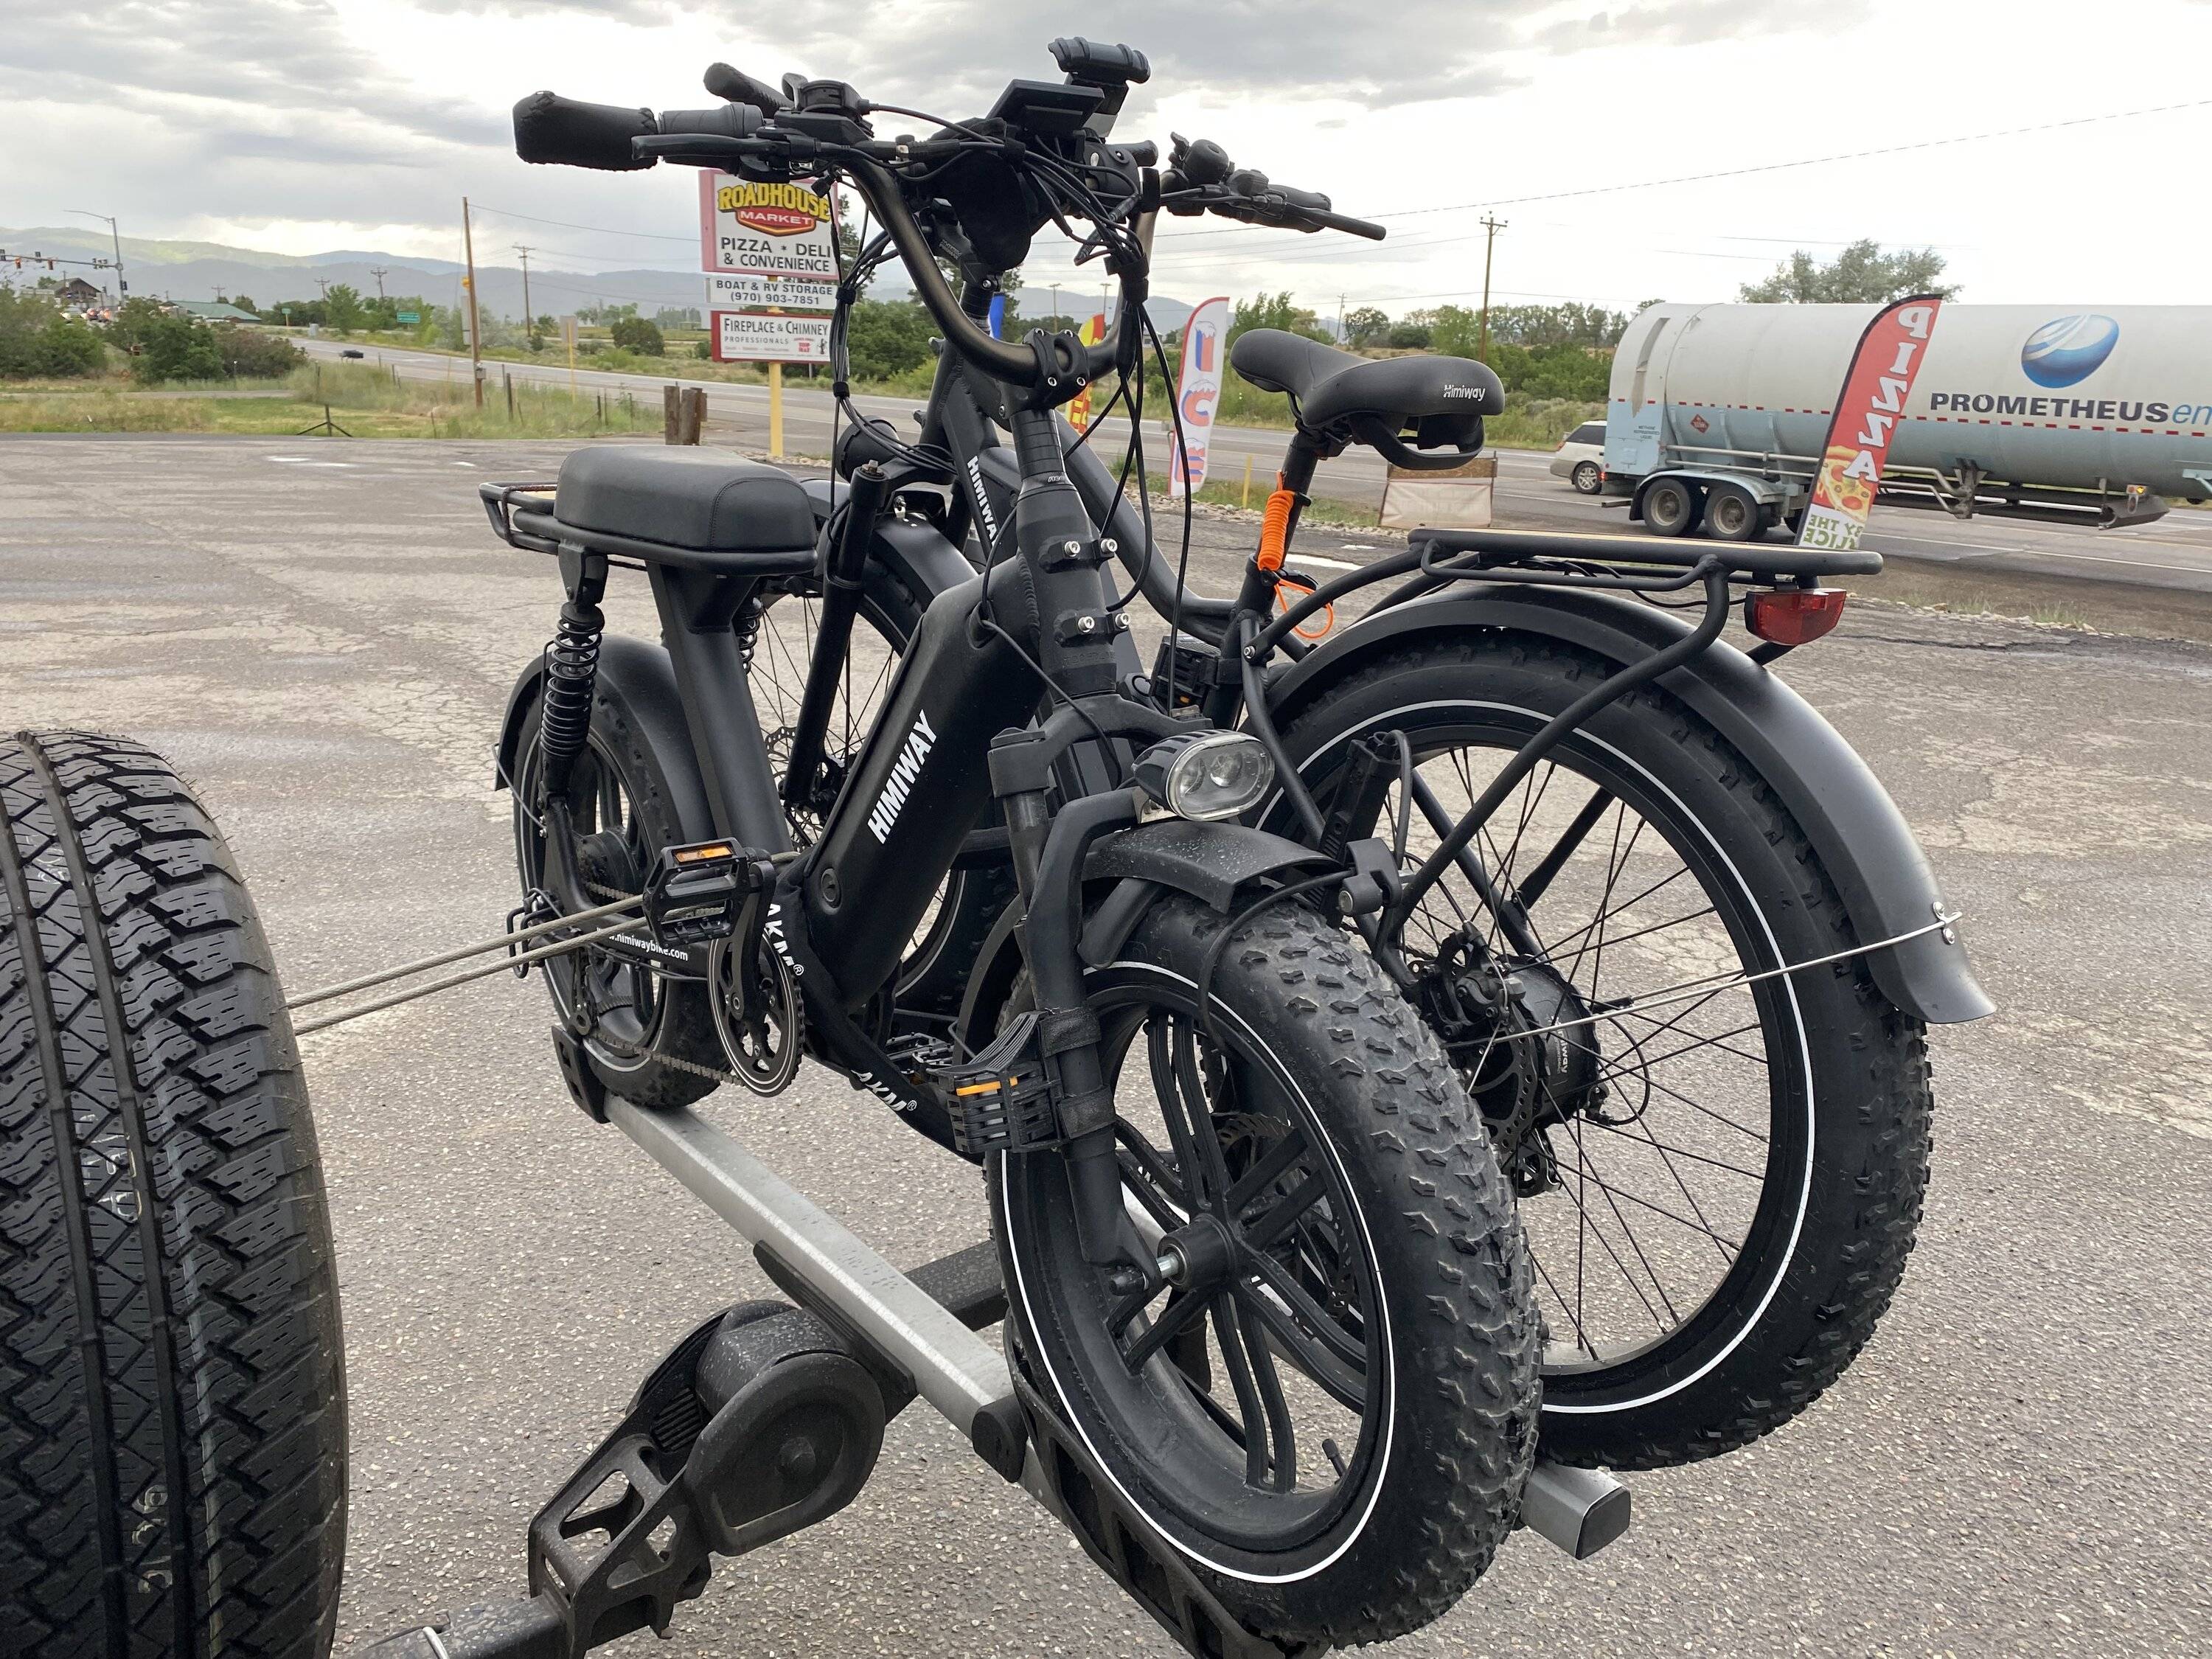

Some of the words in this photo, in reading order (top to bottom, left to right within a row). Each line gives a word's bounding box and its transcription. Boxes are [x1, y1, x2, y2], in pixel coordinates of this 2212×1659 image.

[718, 182, 831, 223] ROADHOUSE
[740, 211, 812, 225] MARKET
[720, 237, 772, 253] PIZZA
[796, 243, 831, 257] DELI
[724, 252, 734, 265] &
[740, 254, 830, 271] CONVENIENCE
[716, 280, 746, 290] BOAT
[751, 281, 759, 291] &
[764, 282, 779, 292] RV
[783, 284, 832, 295] STORAGE
[731, 292, 761, 303] (970)
[765, 293, 820, 305] 903-7851
[724, 318, 775, 333] FIREPLACE
[777, 323, 784, 332] &
[785, 321, 830, 336] CHIMNEY
[724, 335, 790, 345] PROFESSIONALS
[1175, 321, 1217, 483] ICE
[1443, 384, 1486, 402] Himiway
[1930, 392, 2169, 423] PROMETHEUS
[867, 709, 937, 844] HIMIWAY
[596, 927, 689, 961] w.himiwaybike.com
